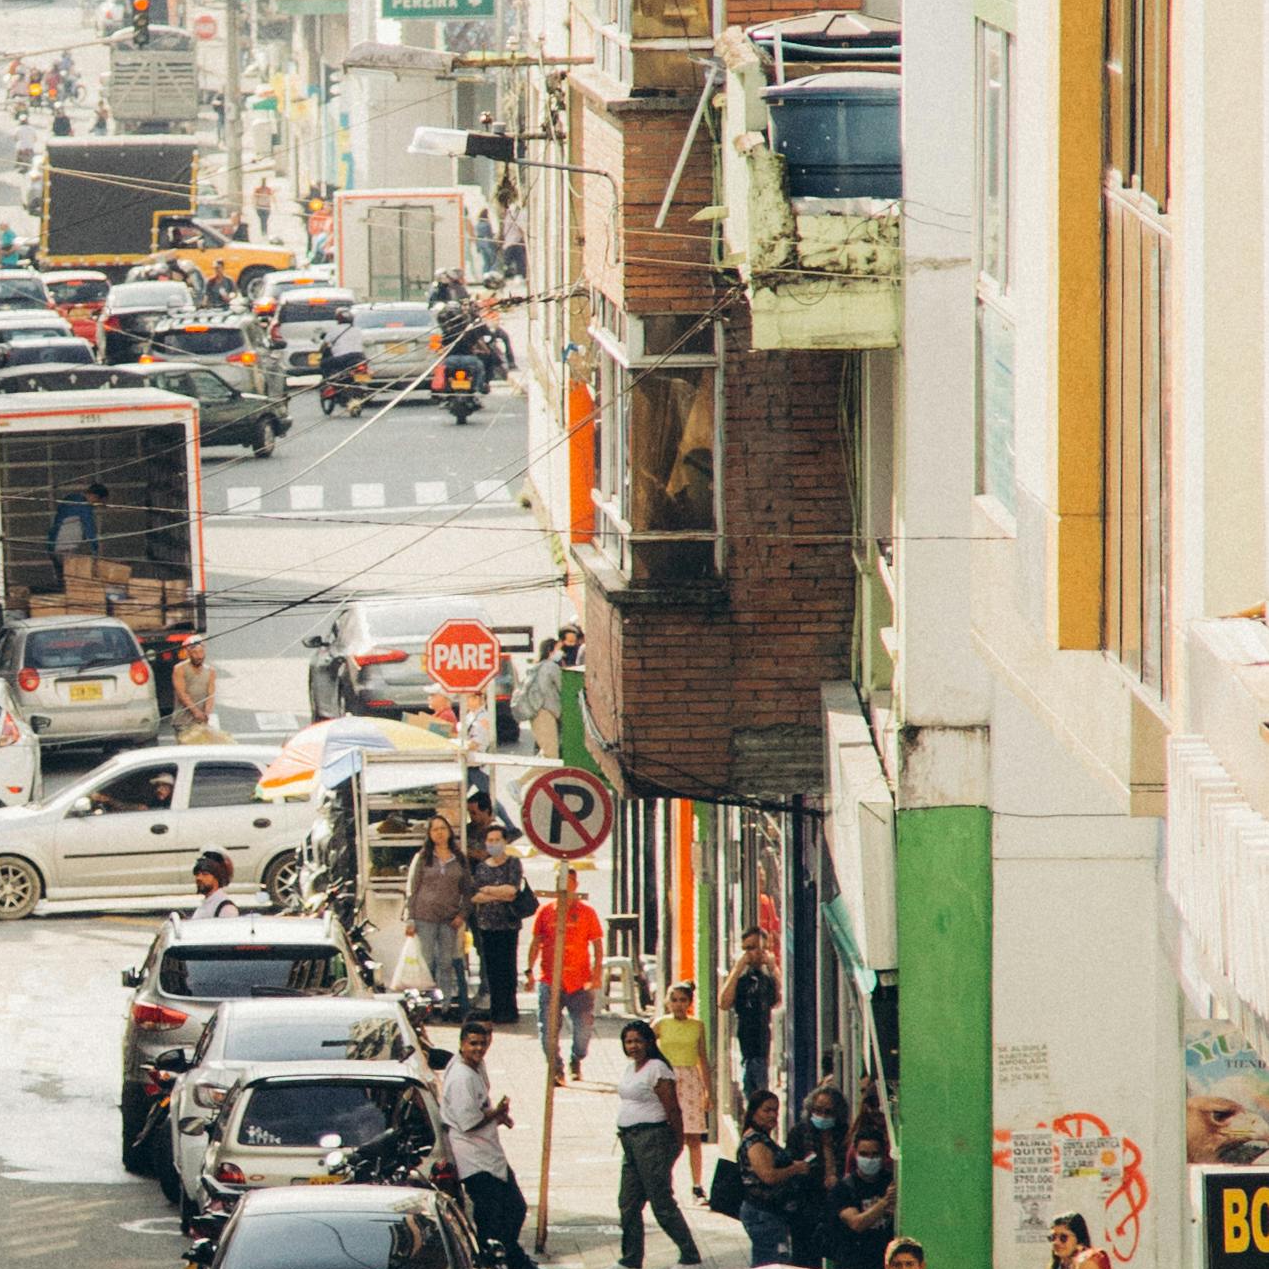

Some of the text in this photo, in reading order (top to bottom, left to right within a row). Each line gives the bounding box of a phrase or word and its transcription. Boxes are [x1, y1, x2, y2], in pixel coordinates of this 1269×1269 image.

[434, 643, 494, 671] PARE
[1224, 1059, 1267, 1068] TIEND
[1013, 1148, 1052, 1156] QUITO
